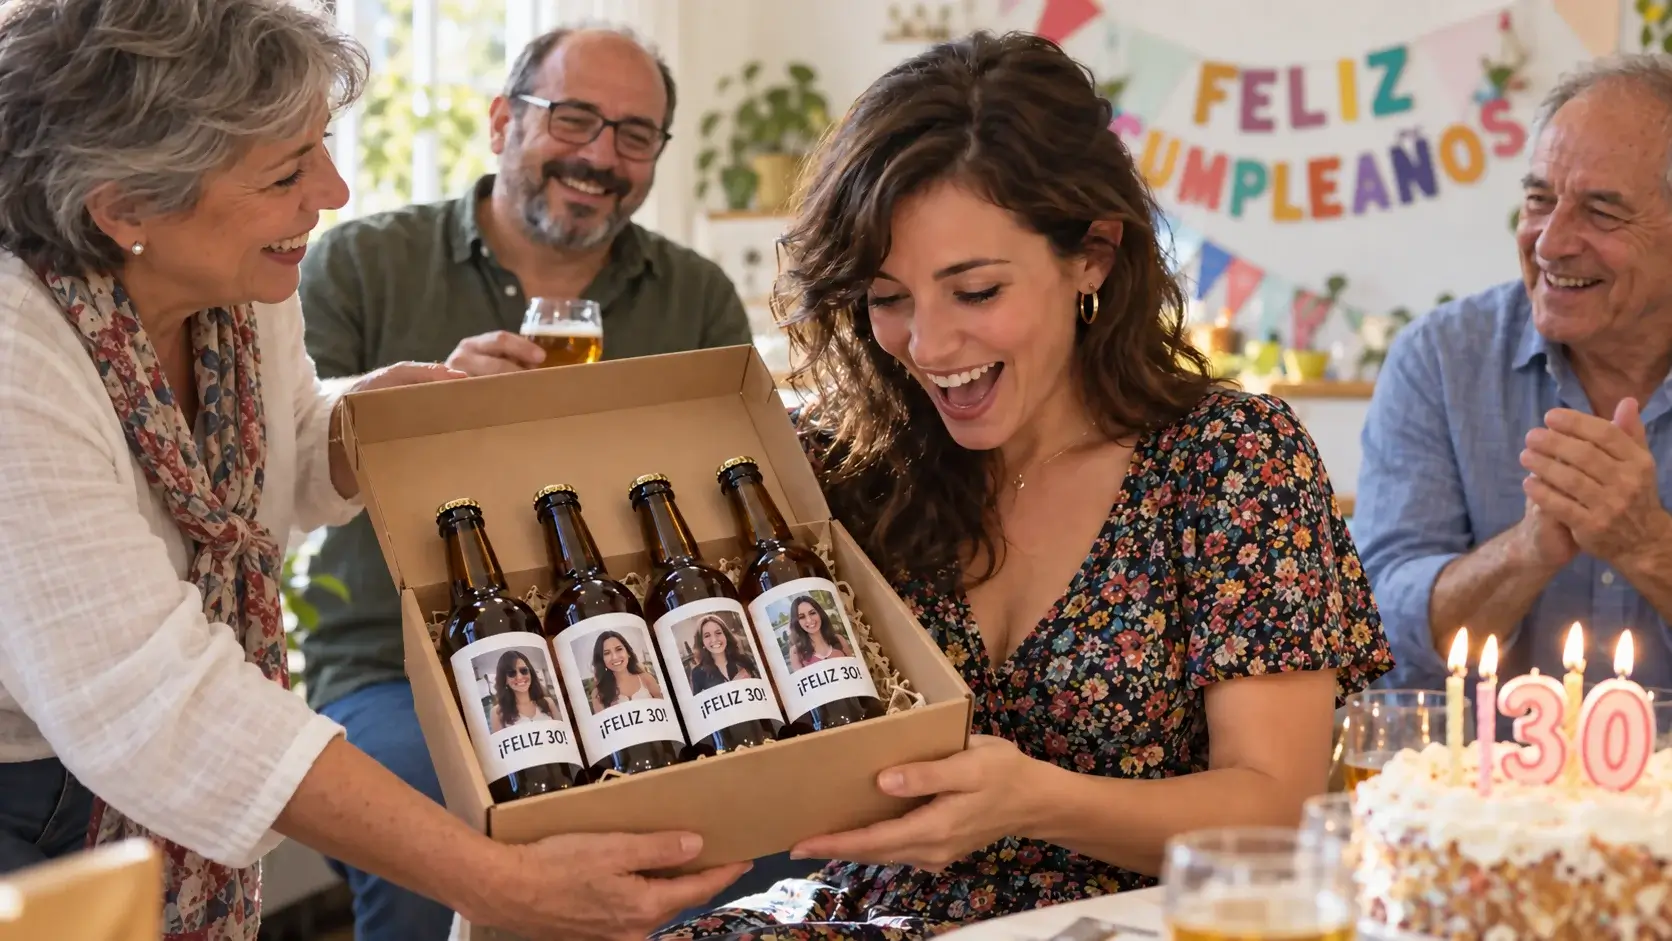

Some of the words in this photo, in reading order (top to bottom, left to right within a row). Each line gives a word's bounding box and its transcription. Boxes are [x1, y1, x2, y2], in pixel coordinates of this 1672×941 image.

[1193, 45, 1413, 132] FELIZ
[797, 668, 840, 697] ¡FELIZ
[843, 666, 863, 680] 30!
[700, 690, 743, 719] ¡FELIZ
[747, 687, 767, 702] 30!
[600, 710, 643, 739] ¡FELIZ
[648, 707, 669, 723] 30!
[1498, 673, 1656, 792] 30
[498, 731, 543, 759] ¡FELIZ
[548, 729, 568, 745] 30!
